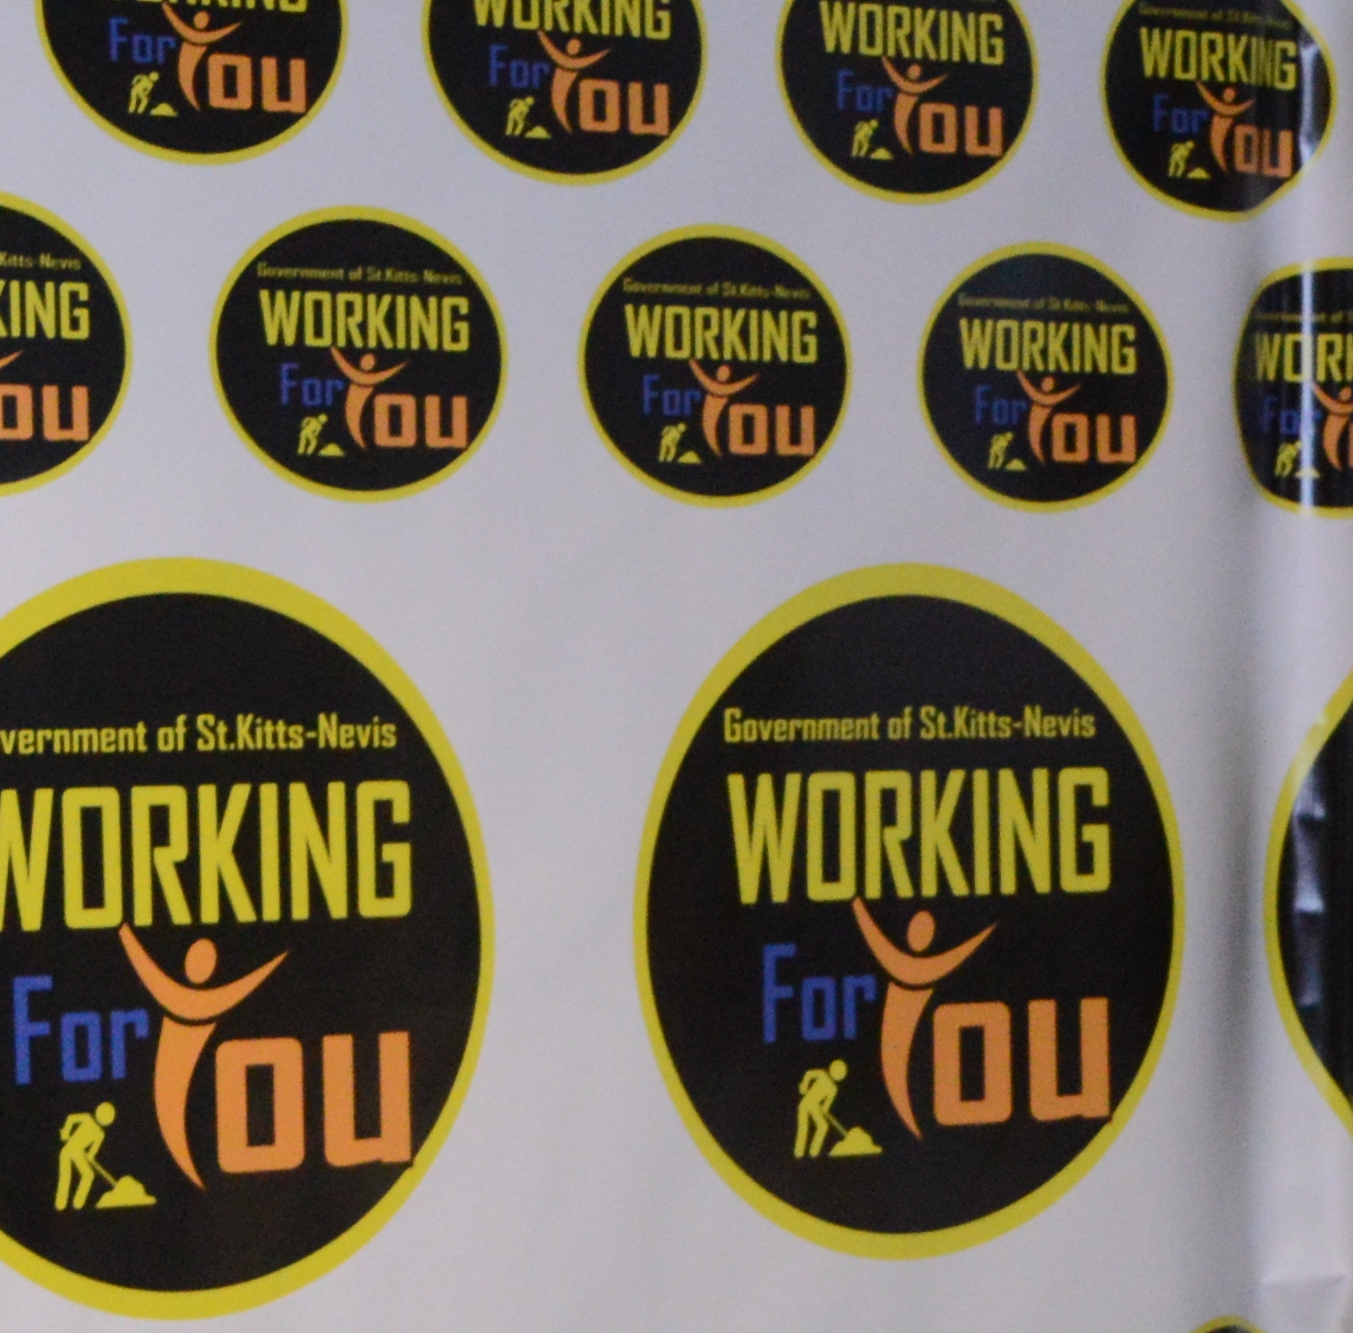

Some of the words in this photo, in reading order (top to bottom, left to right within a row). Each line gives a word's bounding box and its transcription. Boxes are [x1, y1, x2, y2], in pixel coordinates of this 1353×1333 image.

[1139, 26, 1297, 91] WORKING
[259, 290, 468, 353] WORKING
[624, 304, 816, 365] WORKING
[958, 319, 1136, 375] WORKING
[278, 362, 346, 407] For
[641, 373, 703, 416] For
[972, 383, 1029, 424] For
[0, 718, 149, 759] vernment
[158, 714, 186, 753] of
[722, 713, 880, 750] Government
[887, 706, 911, 741] of
[0, 779, 411, 937] WORKING
[724, 762, 1108, 907] WORKING
[758, 941, 880, 1041] For
[5, 975, 152, 1087] For
